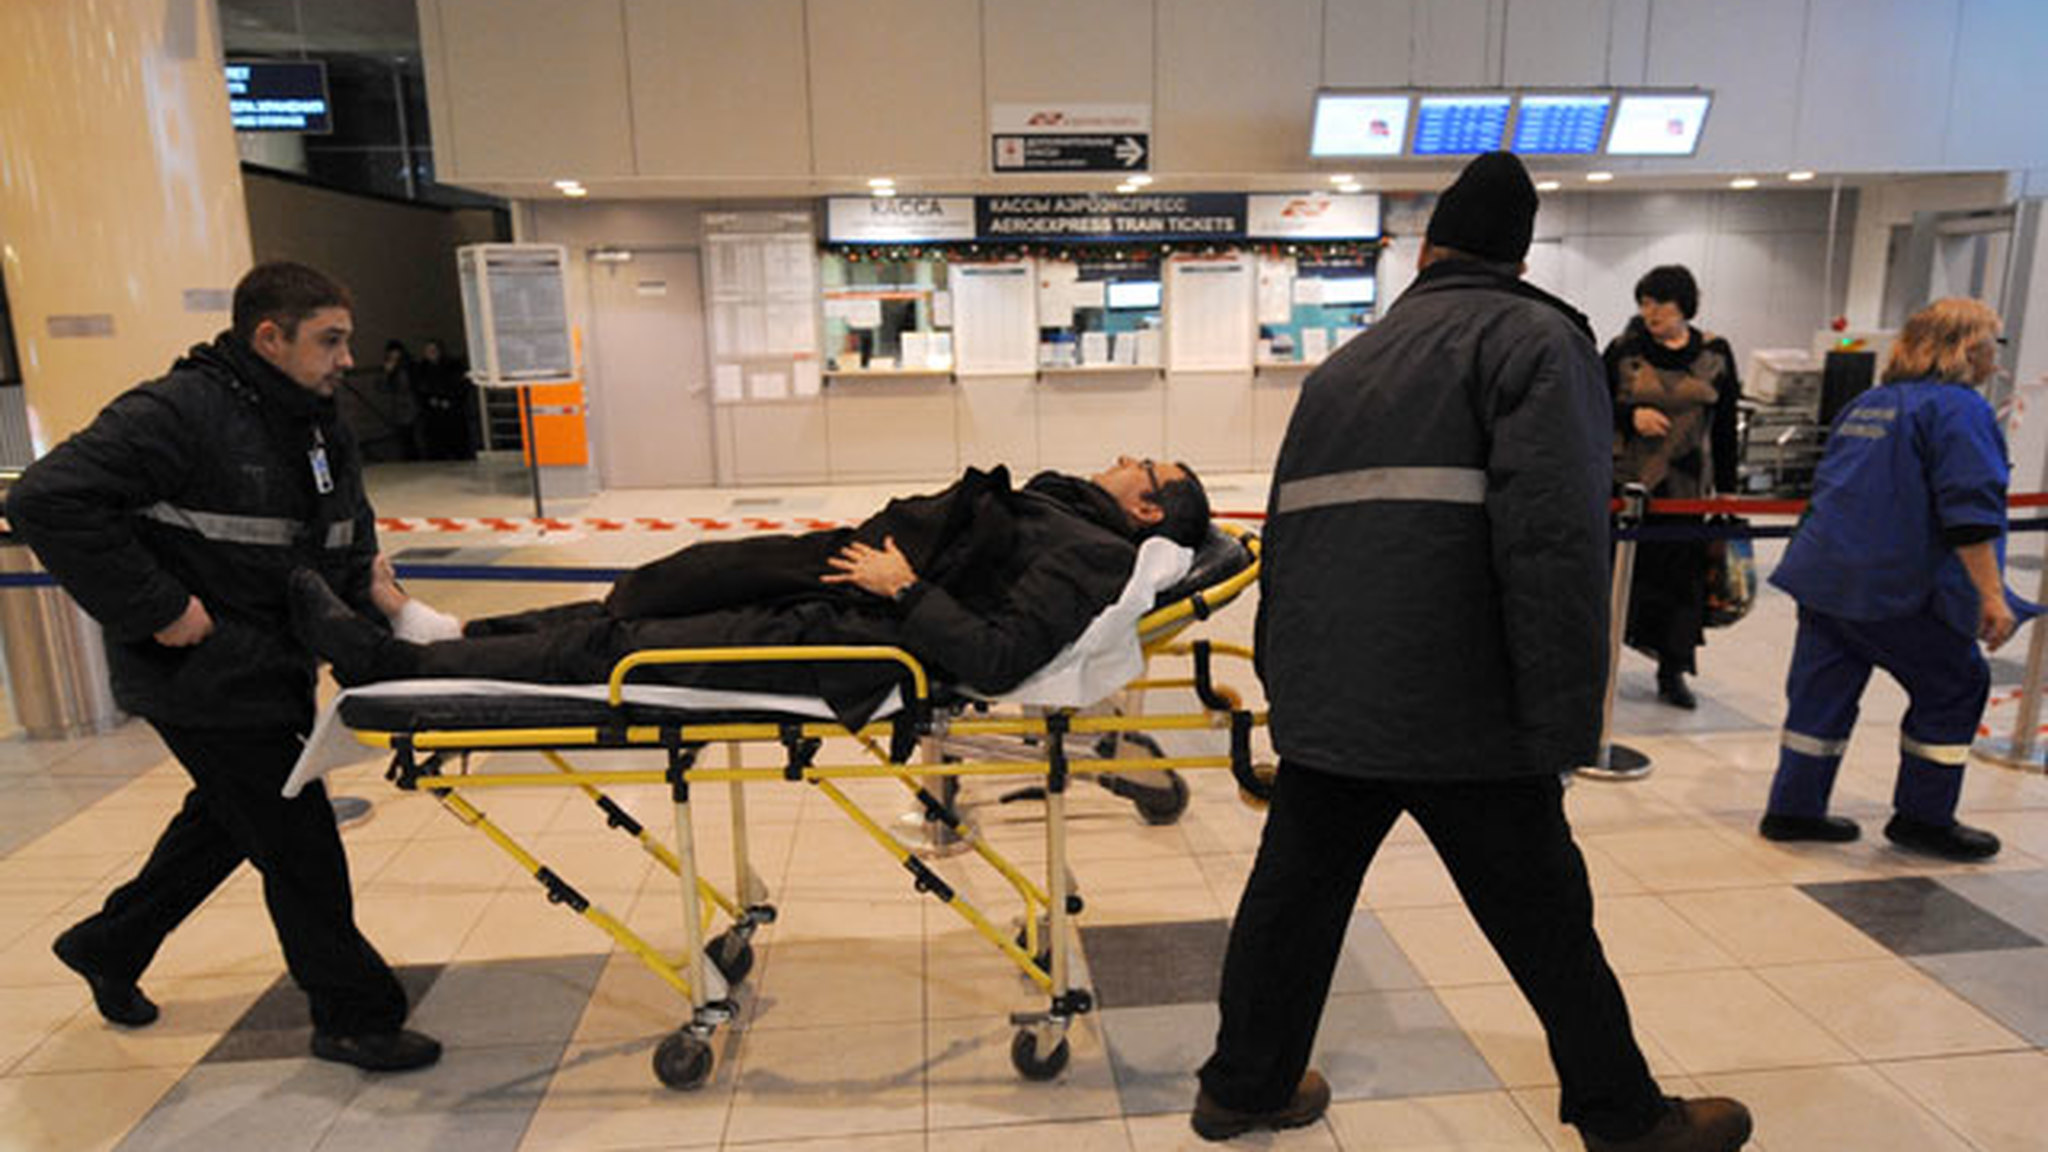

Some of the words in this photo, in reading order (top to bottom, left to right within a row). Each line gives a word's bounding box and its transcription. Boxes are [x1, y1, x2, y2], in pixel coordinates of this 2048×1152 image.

[870, 197, 944, 216] КАССА
[990, 198, 1051, 213] КАССЫ
[990, 217, 1112, 234] AEROEXPRESS
[1116, 217, 1163, 232] TRAIN
[1167, 216, 1236, 232] TICKETS
